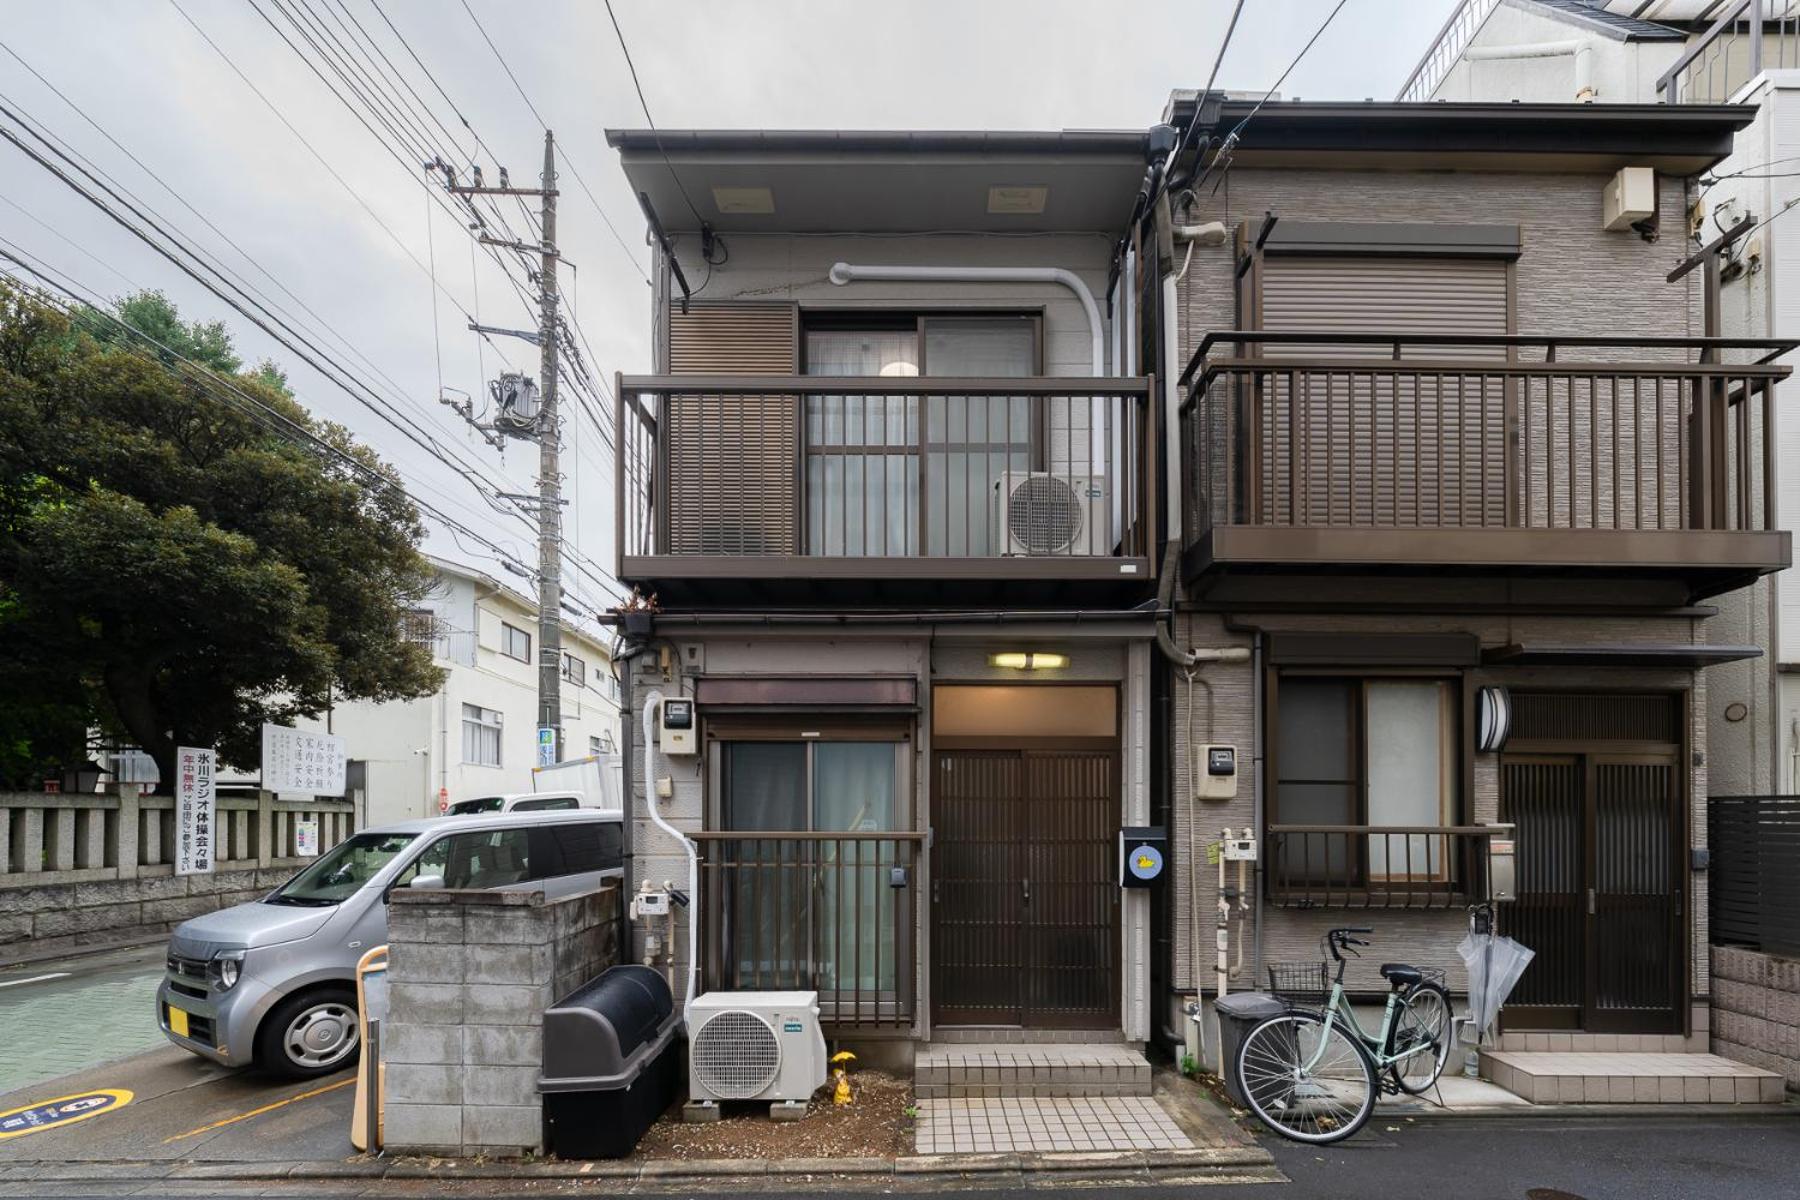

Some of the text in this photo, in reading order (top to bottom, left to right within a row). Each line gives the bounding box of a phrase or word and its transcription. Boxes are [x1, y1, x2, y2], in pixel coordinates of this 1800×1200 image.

[183, 755, 194, 792] 年中無休
[294, 736, 303, 788] 交通安全
[305, 737, 314, 788] 家内安全
[195, 753, 210, 870] 氷川ラジオ体操会々場
